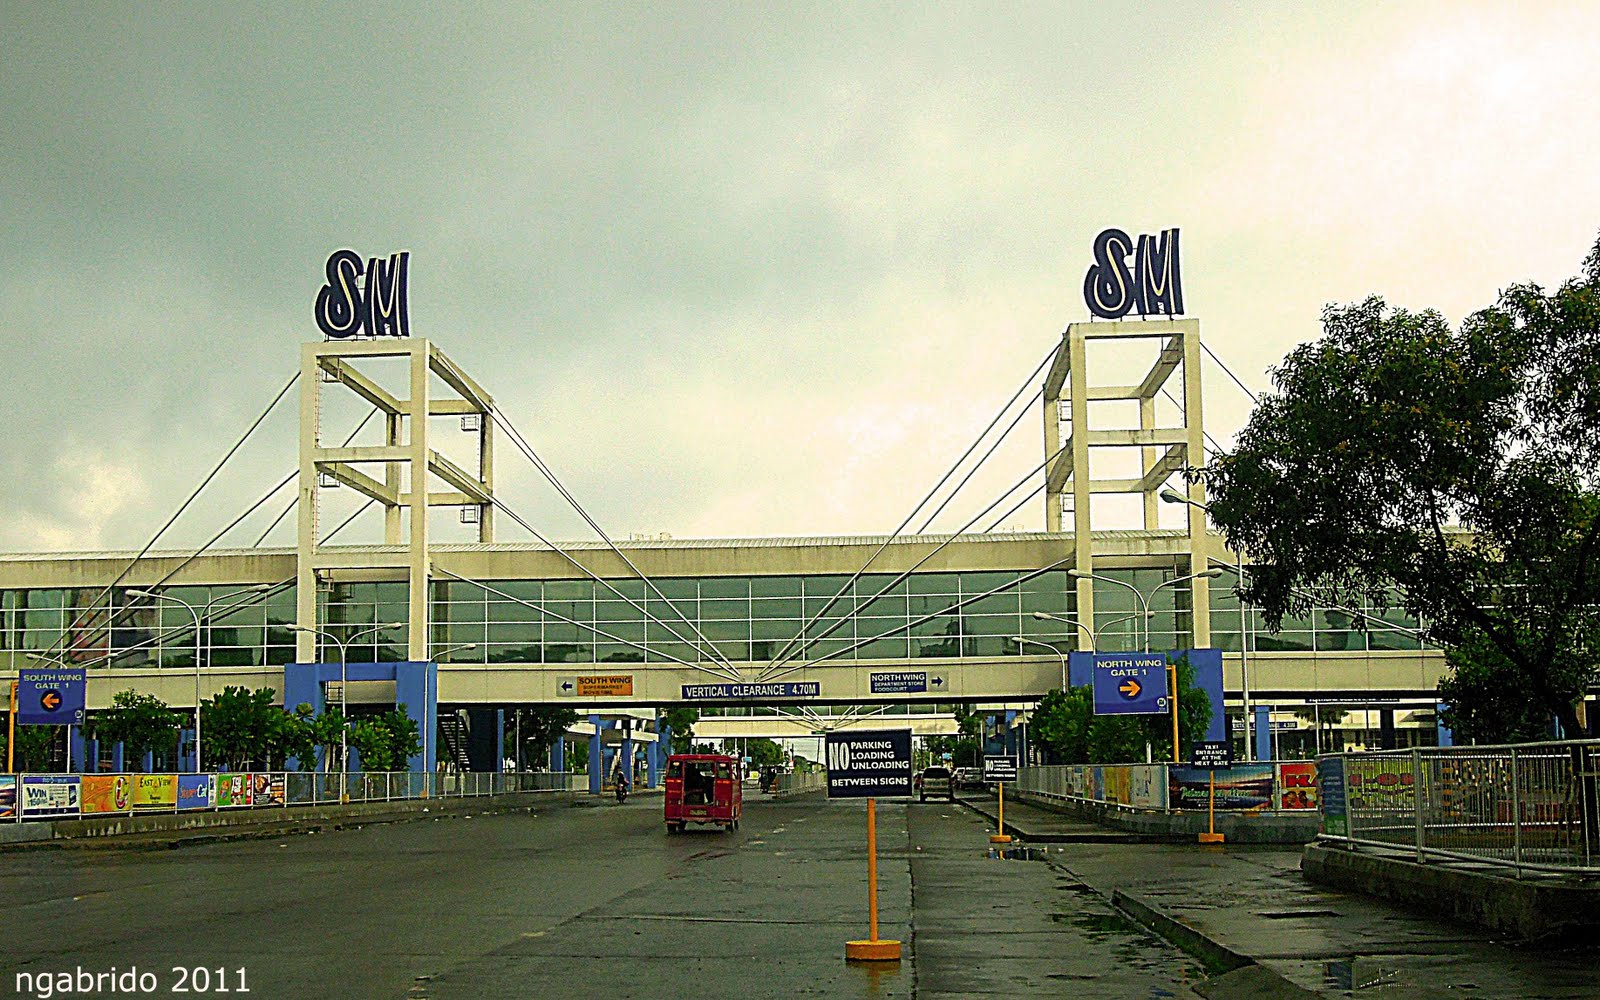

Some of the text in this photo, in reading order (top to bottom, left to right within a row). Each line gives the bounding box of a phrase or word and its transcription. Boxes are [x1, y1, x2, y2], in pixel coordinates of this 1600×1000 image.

[1083, 228, 1184, 319] SM
[315, 250, 410, 338] SM
[1096, 659, 1162, 668] NORTH WING
[1110, 668, 1147, 677] GATE 1
[23, 674, 56, 682] SOUTH
[579, 676, 631, 685] SOUTH WING
[871, 673, 925, 682] NORTH WING
[35, 682, 60, 690] GATE
[686, 683, 816, 698] VERTICAL CLEARANCE 4.70M
[850, 741, 892, 750] PARKING
[828, 742, 850, 771] NO
[851, 751, 895, 760] LOADING
[851, 760, 909, 770] UNLOADING
[985, 760, 994, 771] NO
[831, 777, 908, 787] BETWEEN SIGNS
